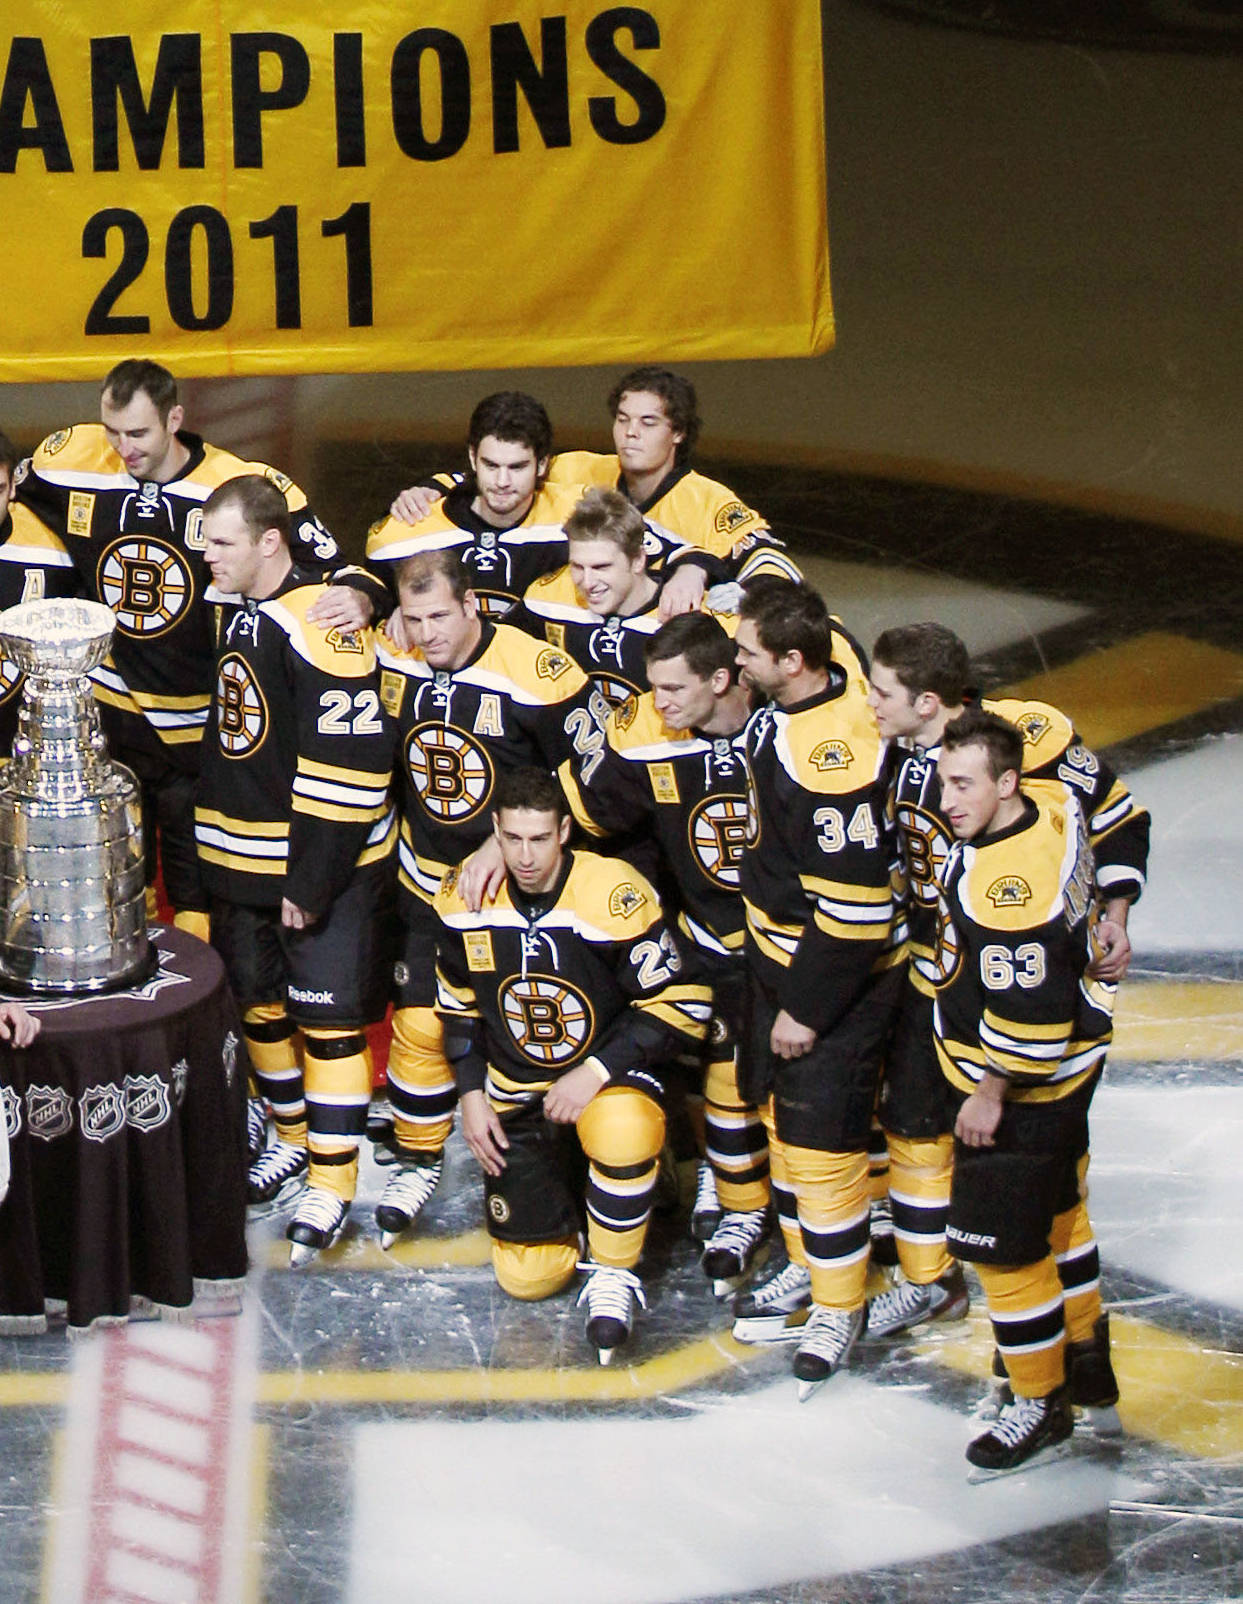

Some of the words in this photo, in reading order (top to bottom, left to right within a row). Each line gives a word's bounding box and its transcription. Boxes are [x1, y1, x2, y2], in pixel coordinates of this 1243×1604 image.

[82, 201, 374, 336] 2011
[122, 558, 168, 616] B
[317, 690, 383, 735] 22
[473, 694, 504, 736] A
[423, 744, 467, 800] B
[1058, 746, 1099, 794] 19
[814, 803, 878, 853] 34
[980, 942, 1046, 990] 63
[517, 996, 566, 1044] B
[35, 1105, 58, 1125] NHL
[89, 1100, 111, 1129] NHL
[132, 1092, 157, 1115] NHL
